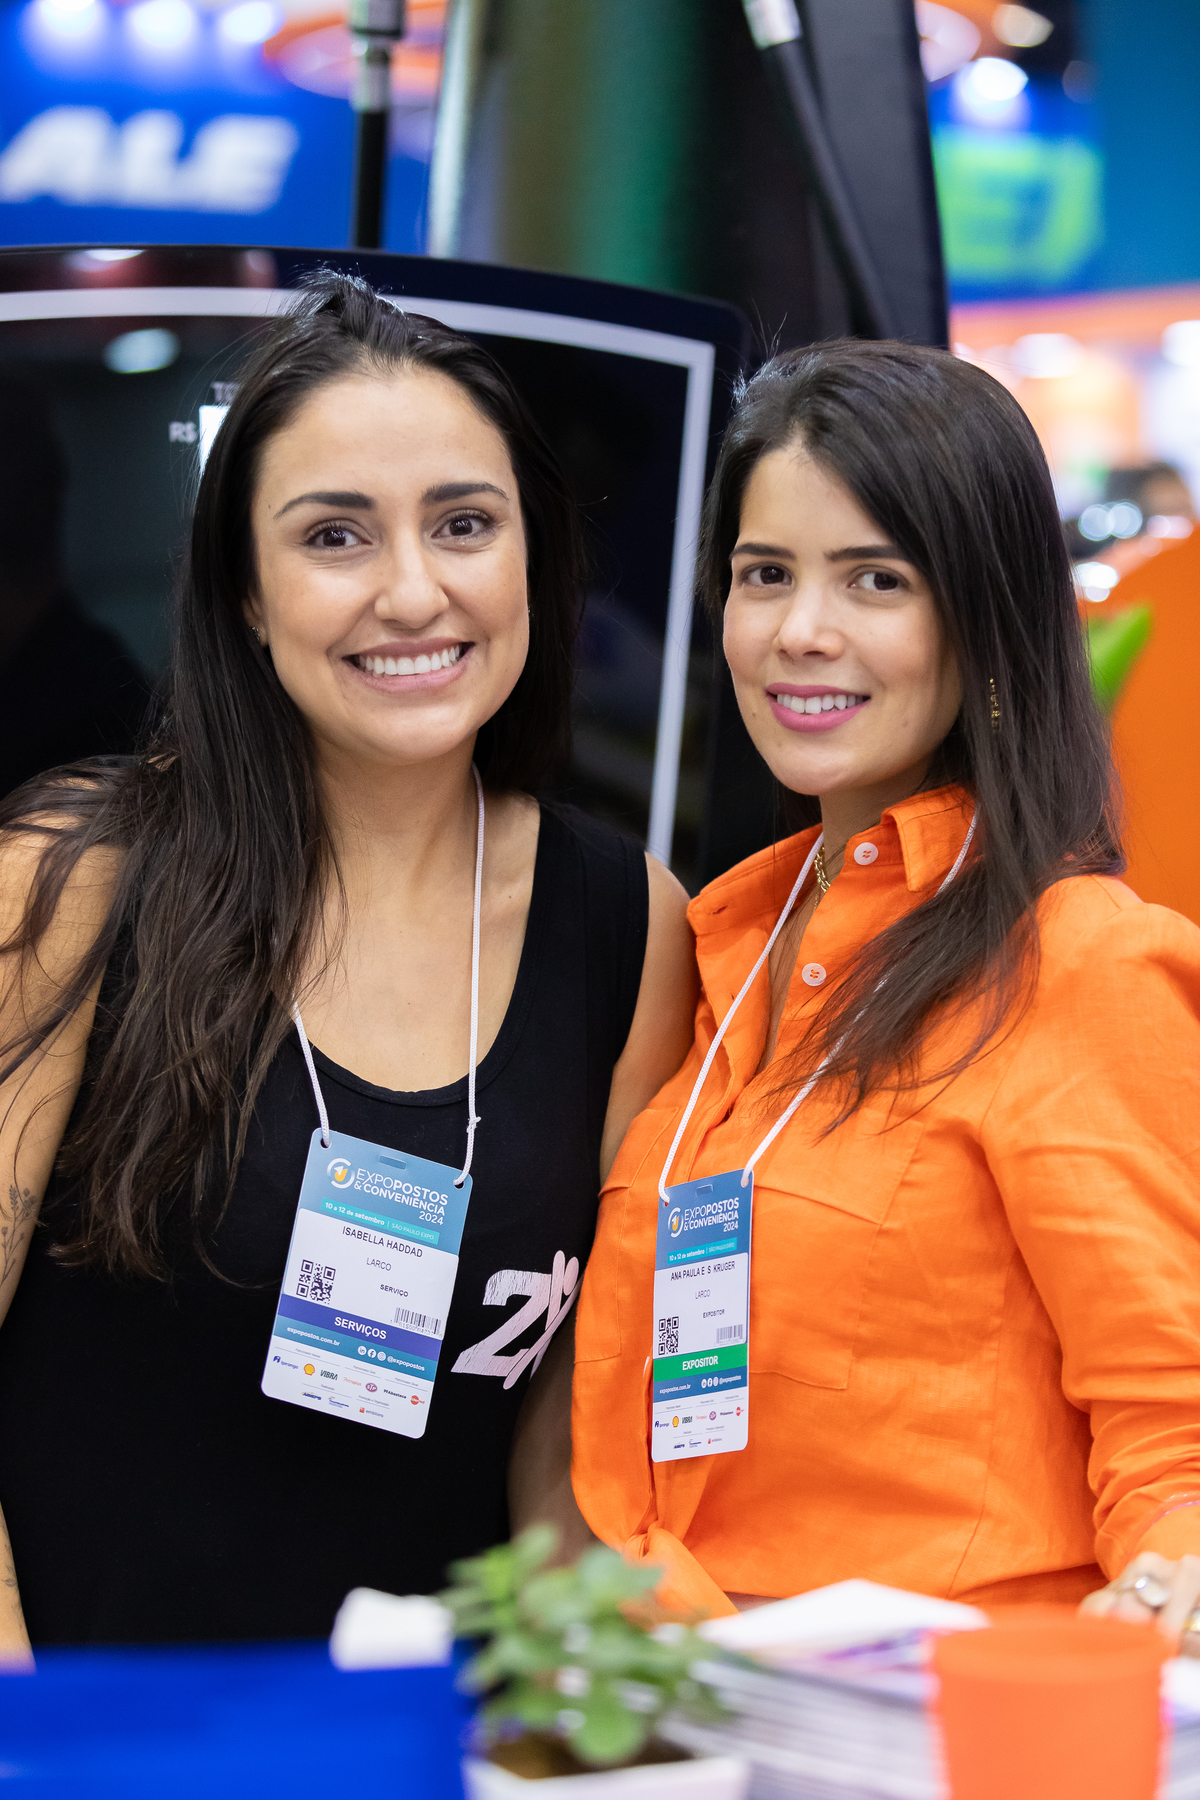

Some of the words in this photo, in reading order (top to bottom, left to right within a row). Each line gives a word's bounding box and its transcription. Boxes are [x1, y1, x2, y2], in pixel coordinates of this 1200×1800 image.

[0, 104, 299, 214] ALE
[168, 421, 197, 443] R$
[356, 1168, 449, 1206] EXPOPOSTOS
[418, 1210, 444, 1225] 2024
[684, 1197, 740, 1221] EXPOPOSTOS
[325, 1202, 333, 1210] 10
[338, 1206, 346, 1214] 12
[354, 1211, 385, 1226] setembro
[403, 1226, 420, 1236] PAULO
[420, 1231, 435, 1240] EXPO
[723, 1220, 739, 1232] 2024
[342, 1226, 385, 1247] ISABELLA
[386, 1239, 423, 1258] HADDAD
[366, 1257, 392, 1271] LARCO
[670, 1271, 683, 1281] ANA
[683, 1268, 700, 1278] PAULA
[713, 1261, 736, 1273] KRUGER
[702, 1308, 725, 1319] EXPOSITOR
[286, 1326, 341, 1347] expopostos.com.br
[334, 1316, 387, 1340] SERVIÇOS
[387, 1355, 425, 1371] @expopostos
[682, 1355, 719, 1370] EXPOSITOR
[320, 1369, 338, 1381] VIBRA
